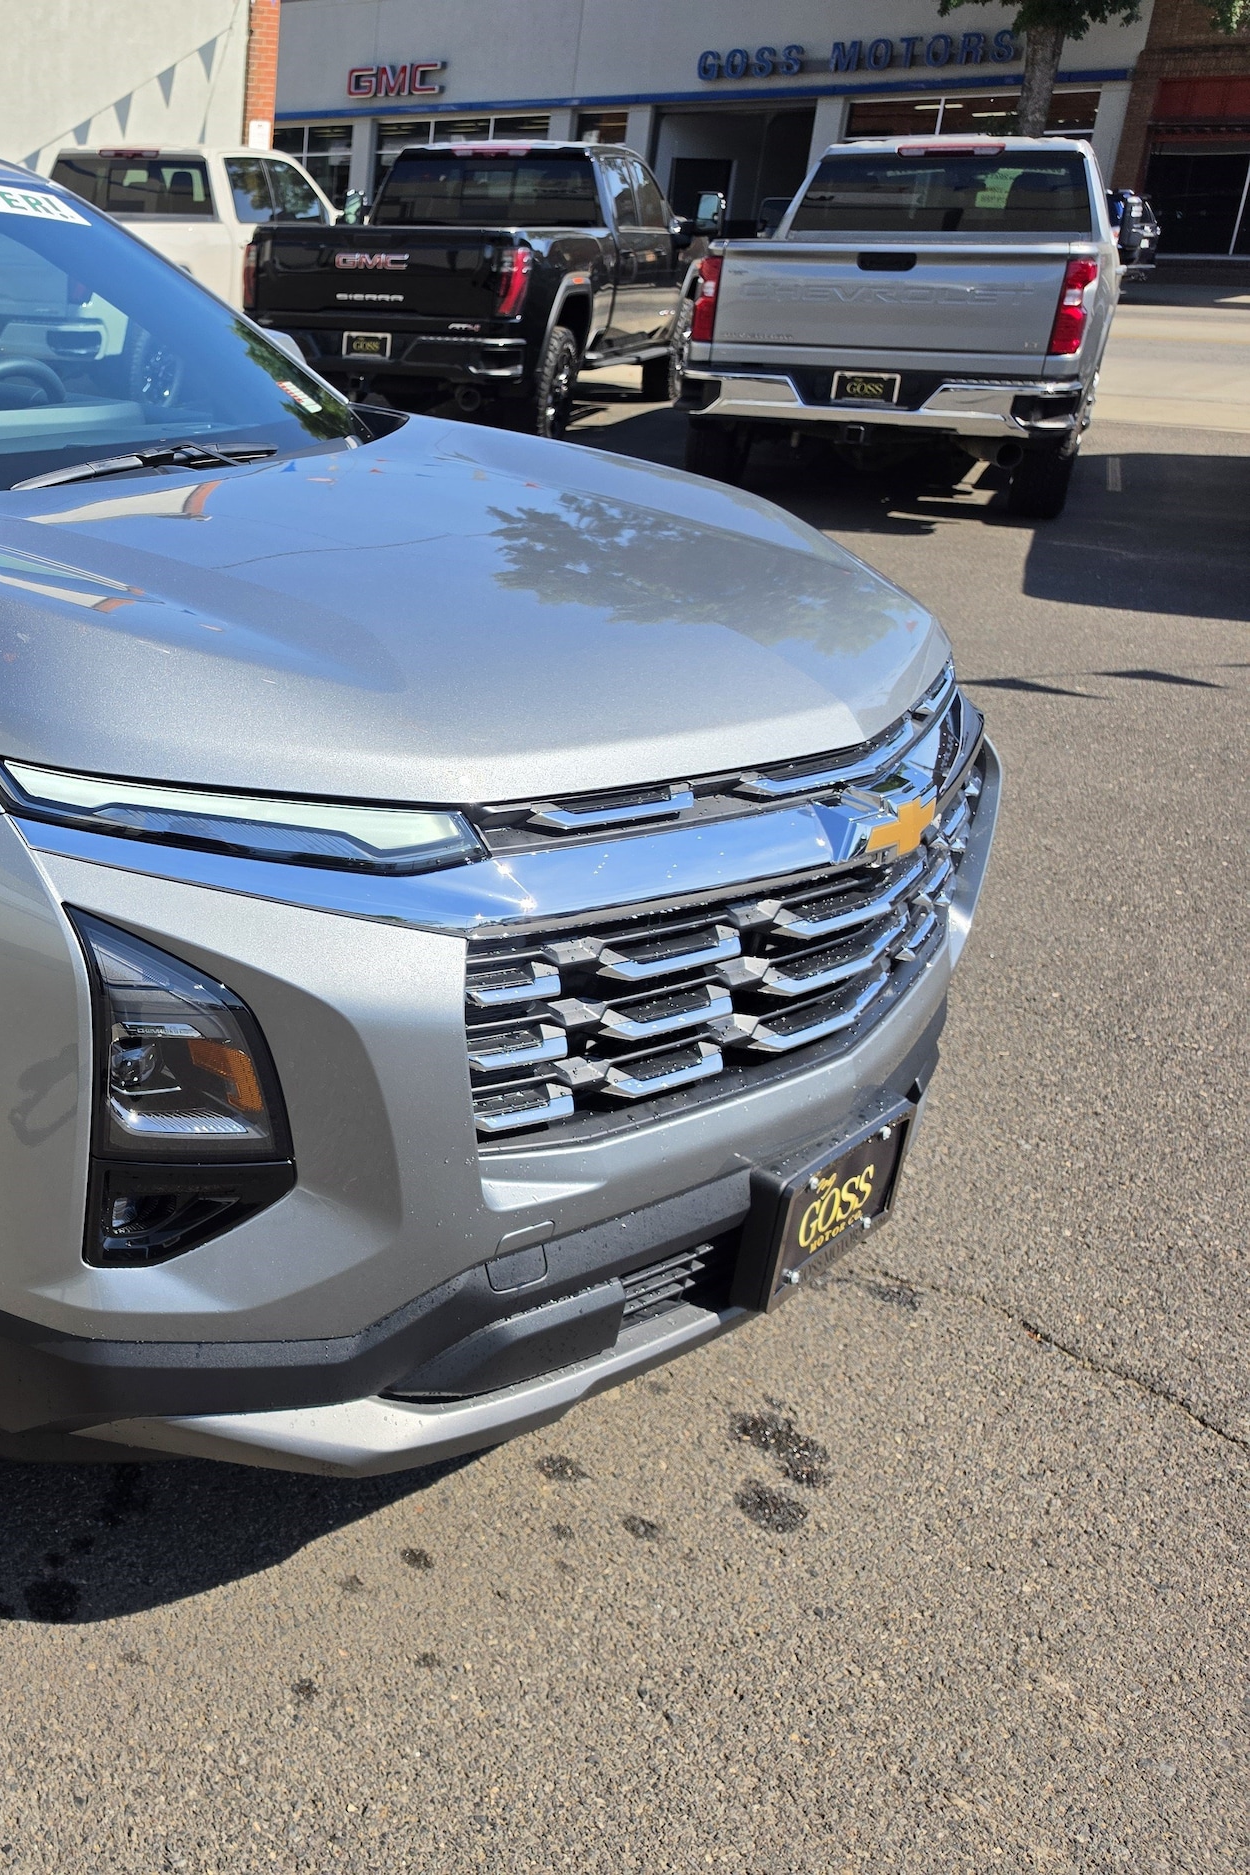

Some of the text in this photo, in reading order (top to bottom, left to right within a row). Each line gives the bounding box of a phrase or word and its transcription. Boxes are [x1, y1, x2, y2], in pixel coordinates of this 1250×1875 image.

[697, 29, 1016, 82] GOSS MOTORS
[347, 61, 443, 98] GMC
[334, 252, 409, 270] GMC
[335, 292, 404, 302] SIERRA
[740, 277, 1035, 305] CHEVROLET
[845, 381, 884, 395] GOSS
[798, 1163, 875, 1248] GOSS
[809, 1221, 846, 1254] MOTOR
